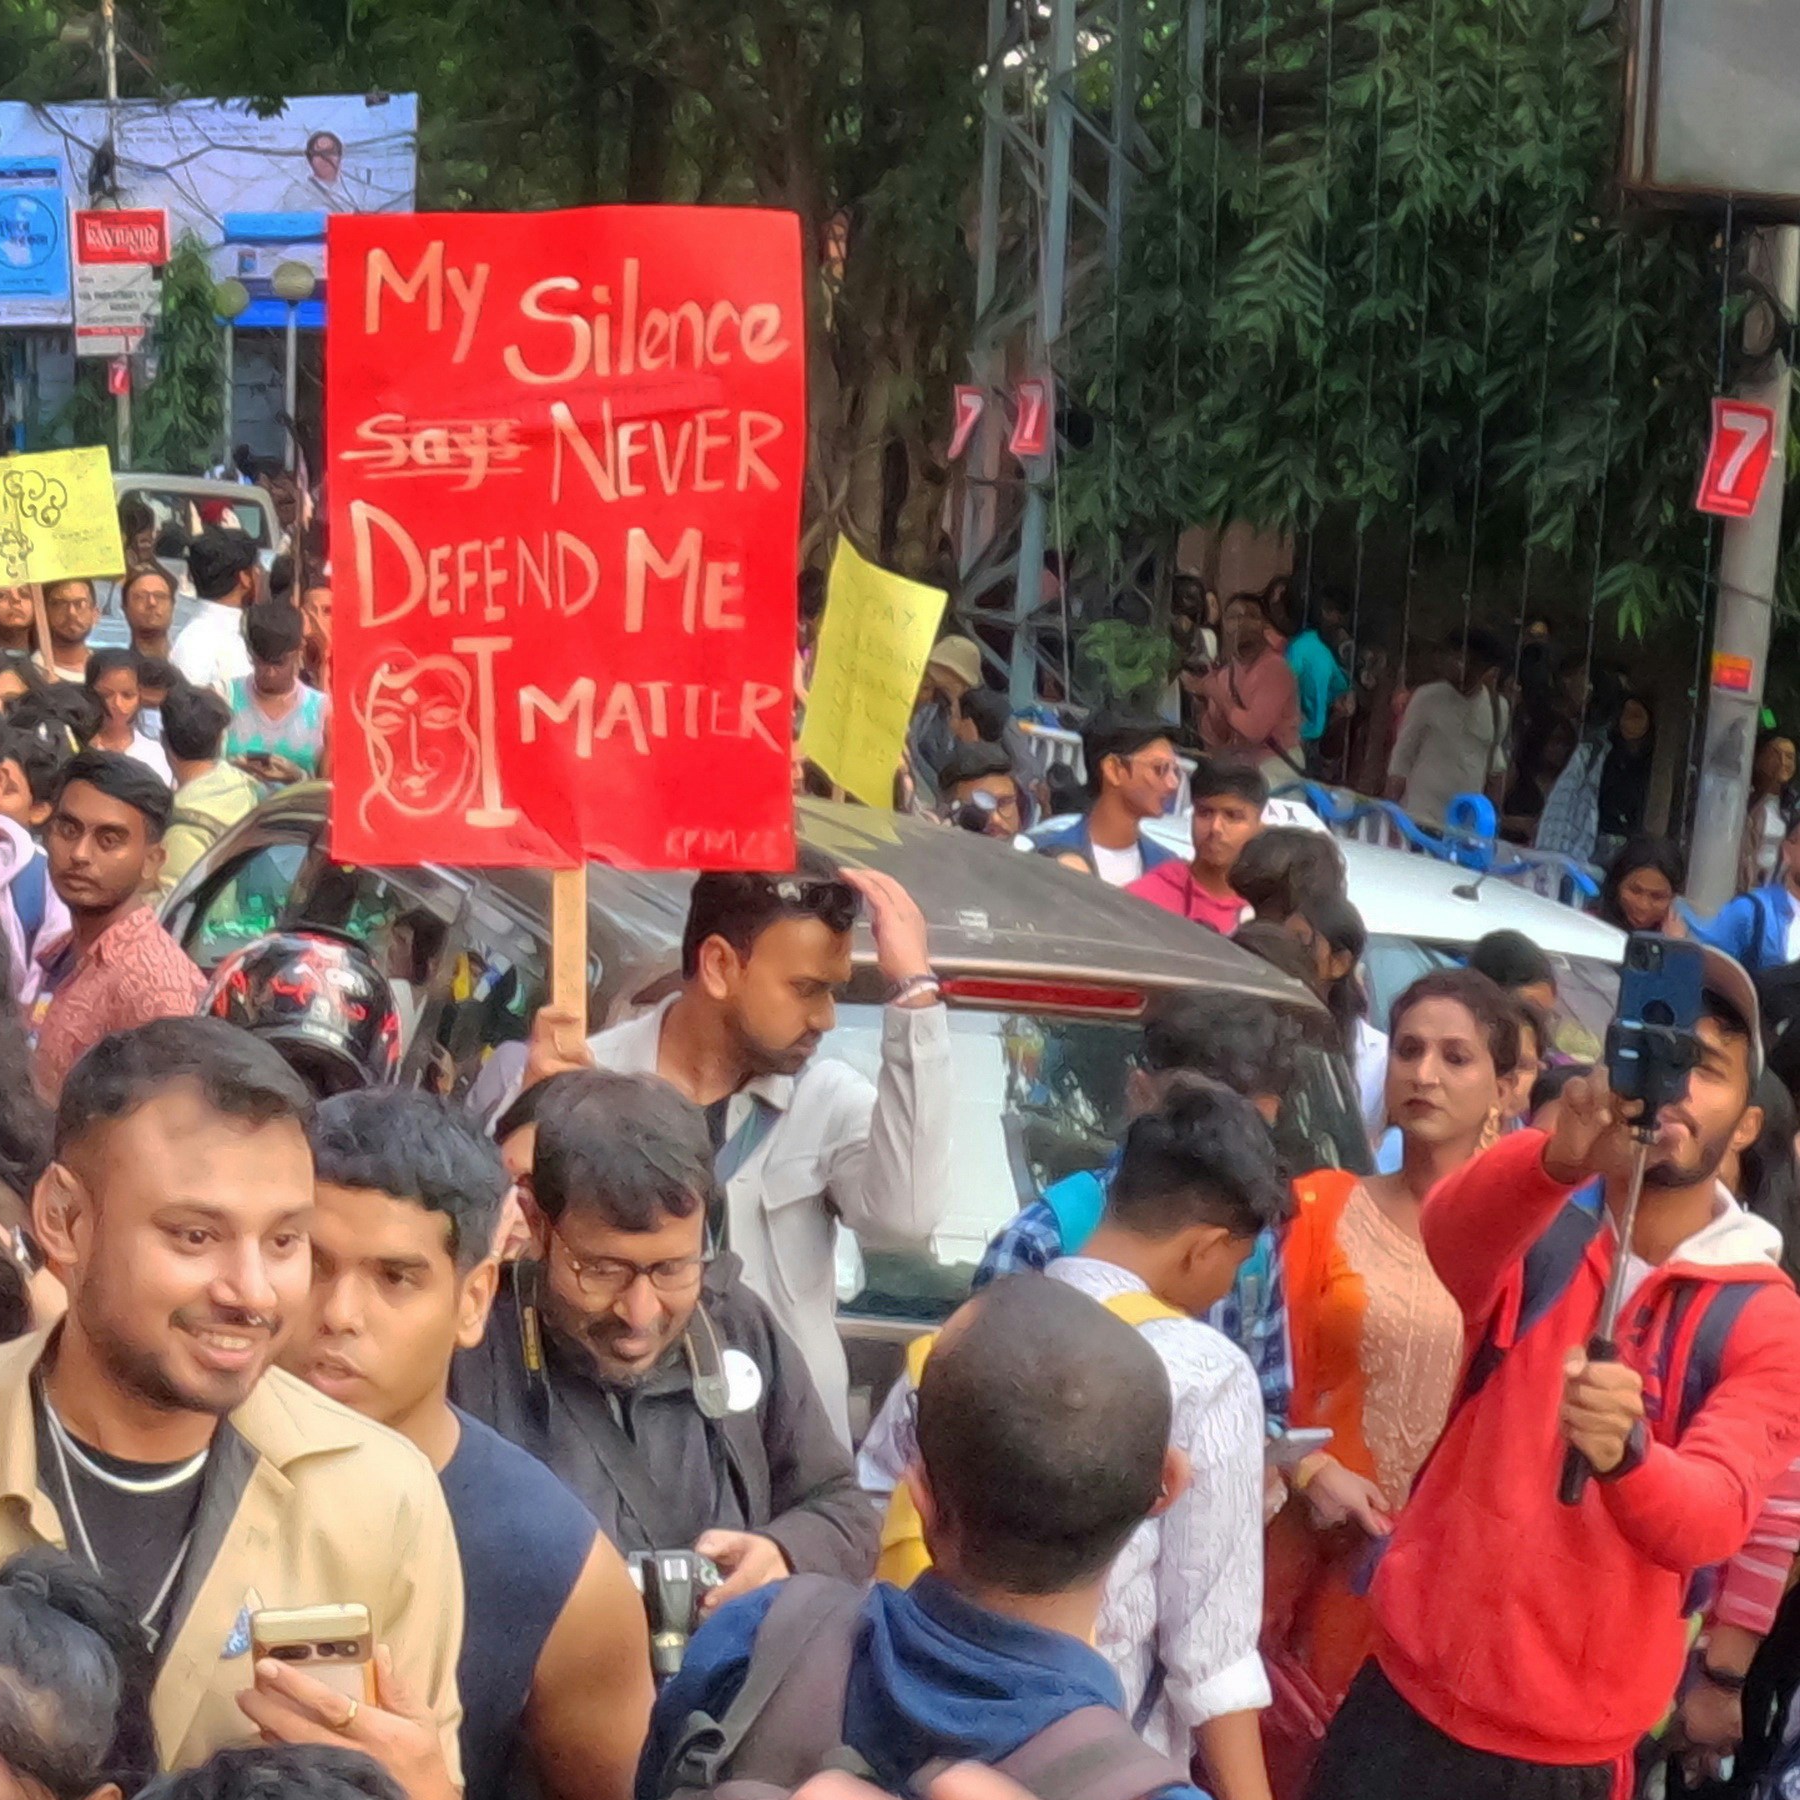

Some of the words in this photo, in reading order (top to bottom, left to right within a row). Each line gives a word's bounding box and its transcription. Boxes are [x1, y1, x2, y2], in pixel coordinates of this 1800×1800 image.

[365, 240, 490, 363] My
[504, 258, 791, 385] Silence
[552, 399, 785, 503] NEVER
[1717, 409, 1768, 494] 7
[349, 499, 601, 628] DEFEND
[624, 527, 746, 634] ME
[452, 636, 520, 828] I
[517, 676, 784, 760] MATTER
